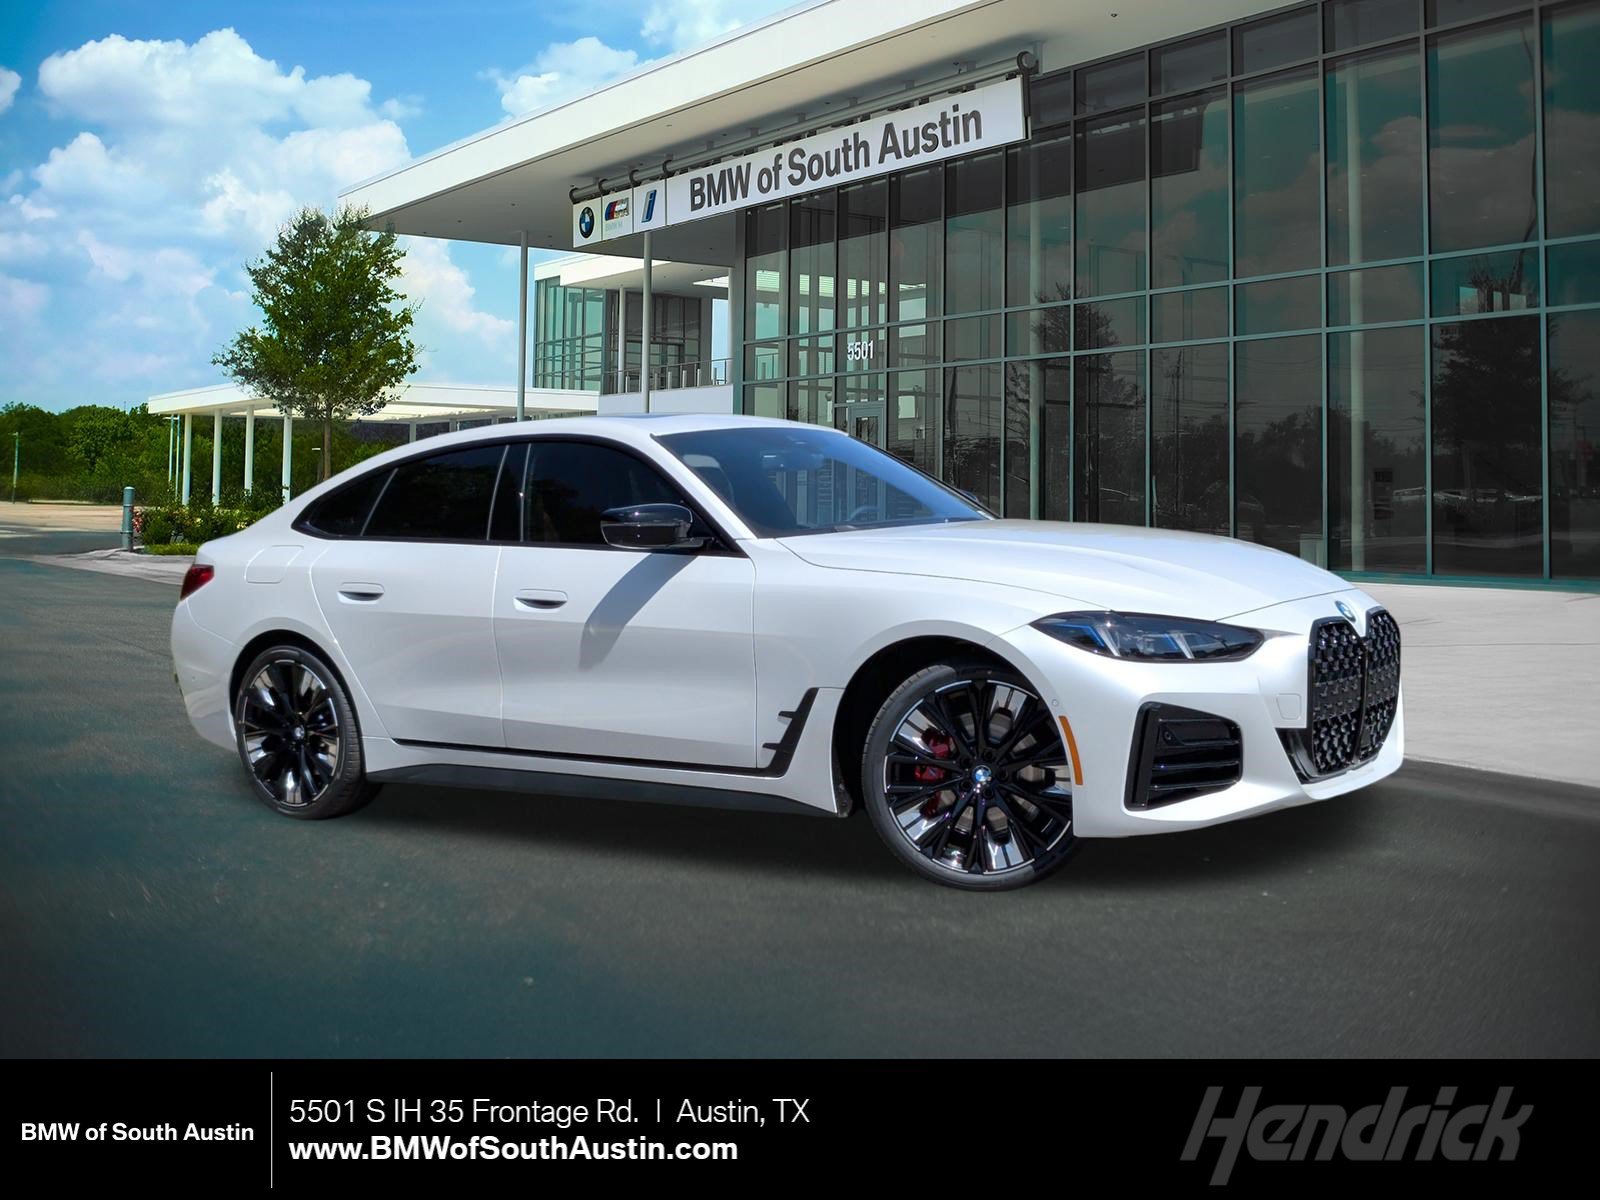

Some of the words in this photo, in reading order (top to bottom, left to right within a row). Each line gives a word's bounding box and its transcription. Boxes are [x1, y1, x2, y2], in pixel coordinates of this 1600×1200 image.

[690, 162, 751, 212] BMW
[757, 153, 783, 194] of
[787, 132, 870, 187] South
[878, 103, 983, 164] Austin
[847, 340, 874, 360] 5501
